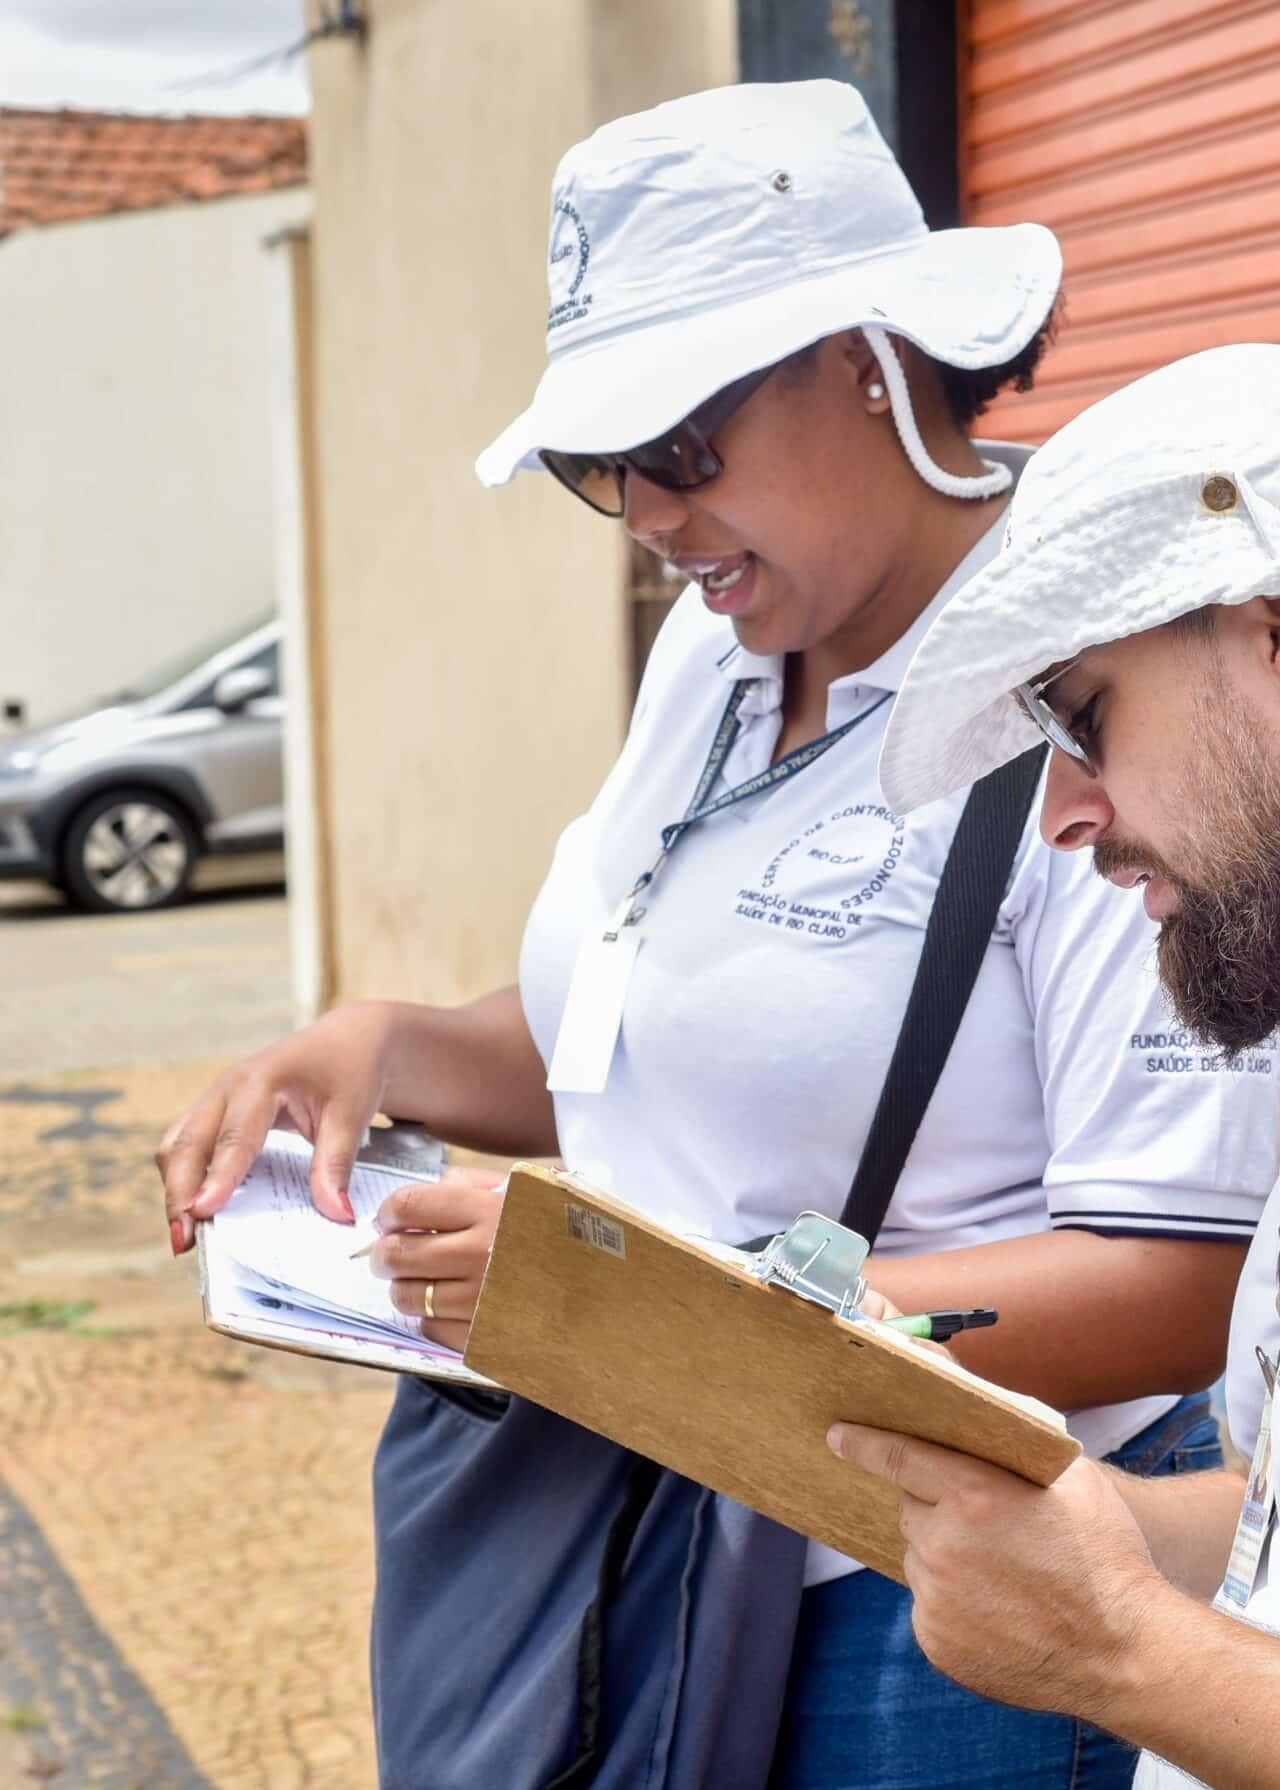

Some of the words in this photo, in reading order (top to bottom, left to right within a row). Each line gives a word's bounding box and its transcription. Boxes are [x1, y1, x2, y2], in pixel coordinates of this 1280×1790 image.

[761, 838, 801, 889] CENTRO
[840, 836, 905, 910] ZOONOSES
[737, 888, 787, 911] FUNDAÇÃO
[789, 903, 842, 922] MUNICIPAL
[846, 912, 863, 926] DE
[767, 912, 784, 926] DE
[784, 917, 804, 931] RIO
[807, 922, 846, 939] CLARO
[1146, 1053, 1194, 1074] SAÚDE
[1201, 1056, 1221, 1073] DE
